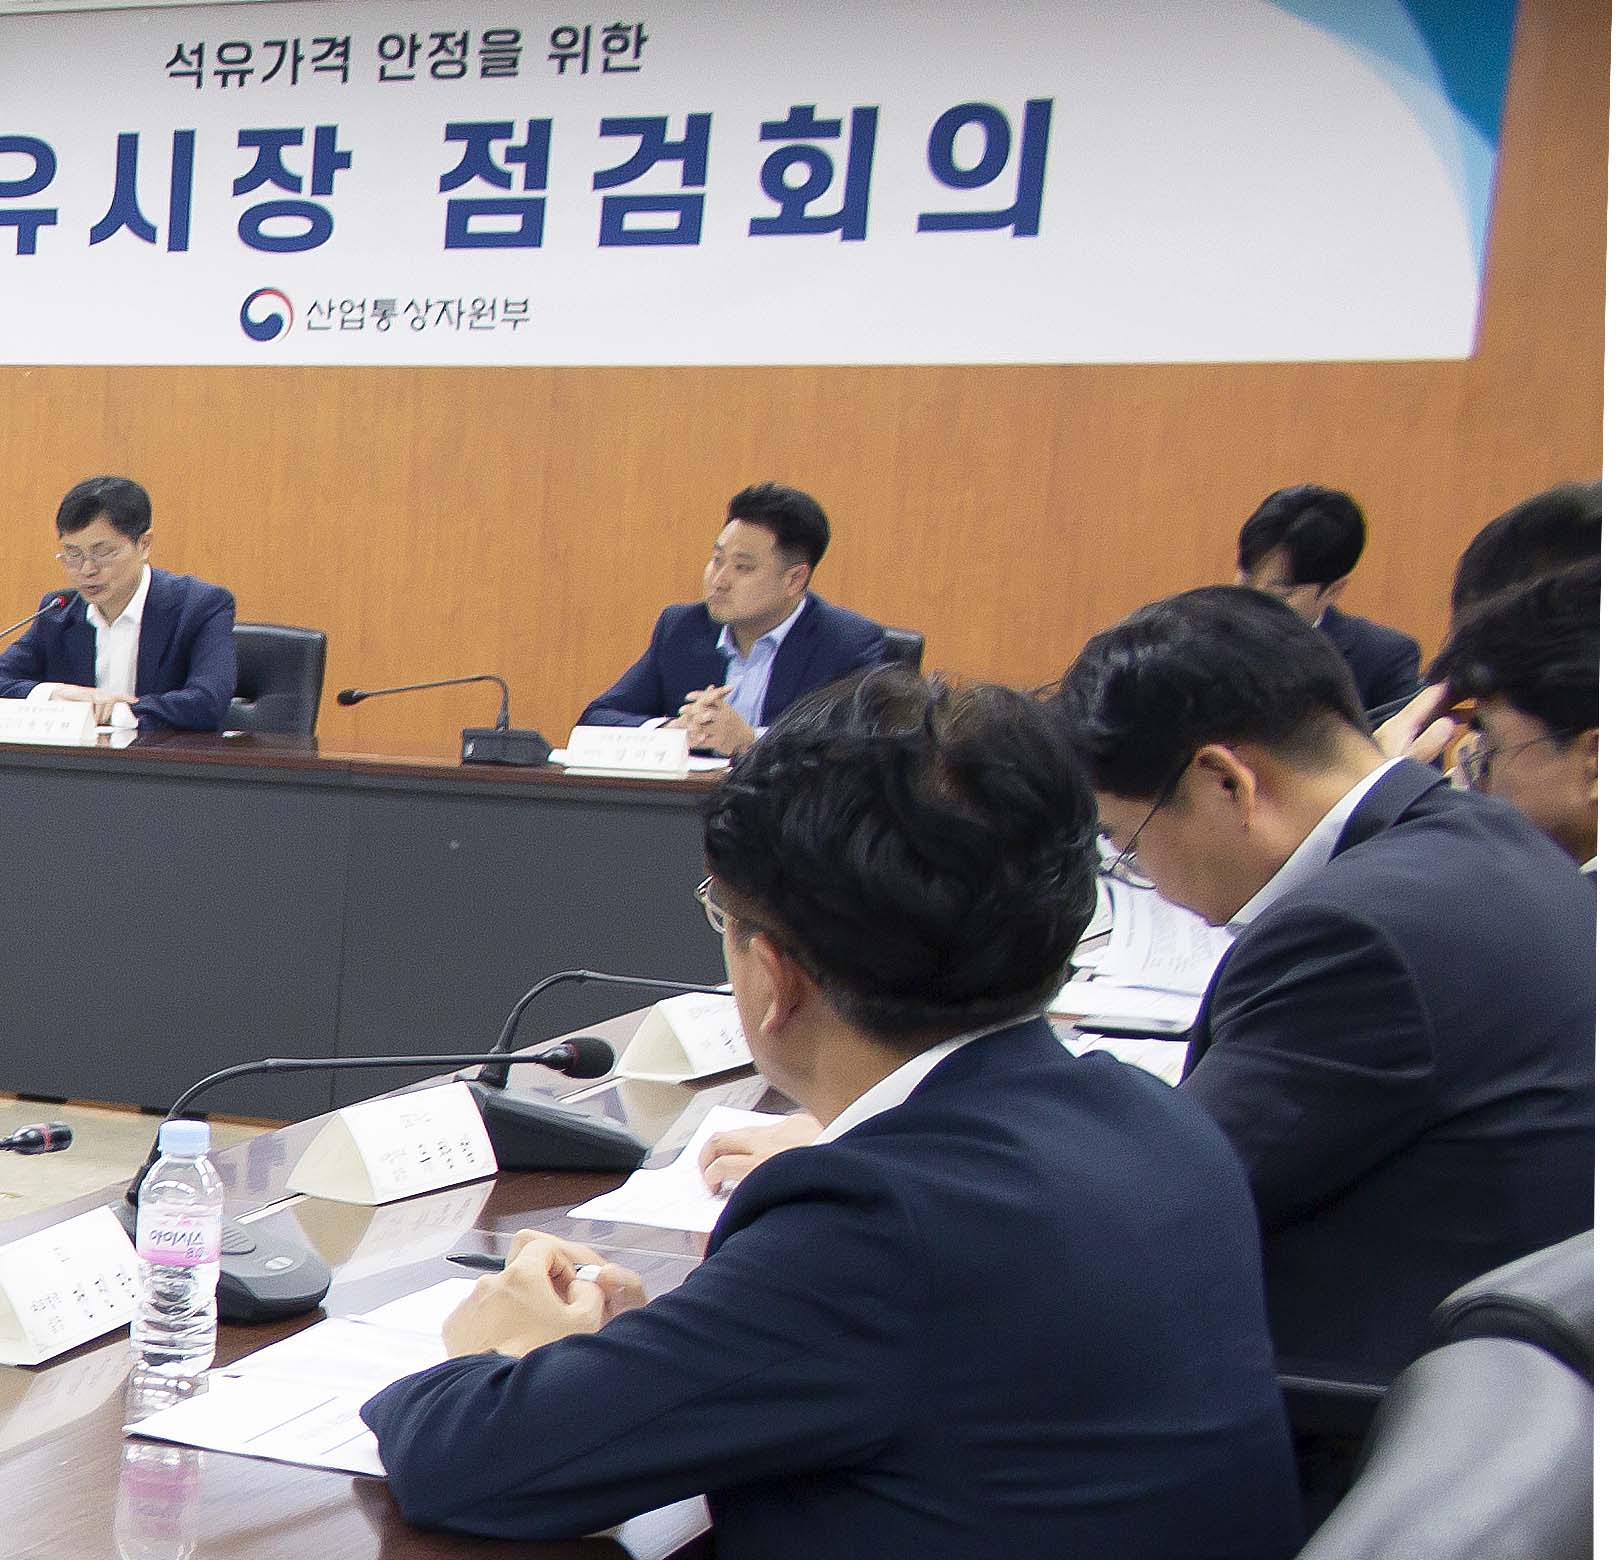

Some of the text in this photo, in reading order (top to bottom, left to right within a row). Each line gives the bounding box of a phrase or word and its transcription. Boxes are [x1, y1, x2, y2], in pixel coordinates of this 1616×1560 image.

[164, 21, 649, 90] 석유가격 안정을 위한
[438, 97, 1055, 250] 점검회의
[306, 298, 530, 332] 산업통상자원부
